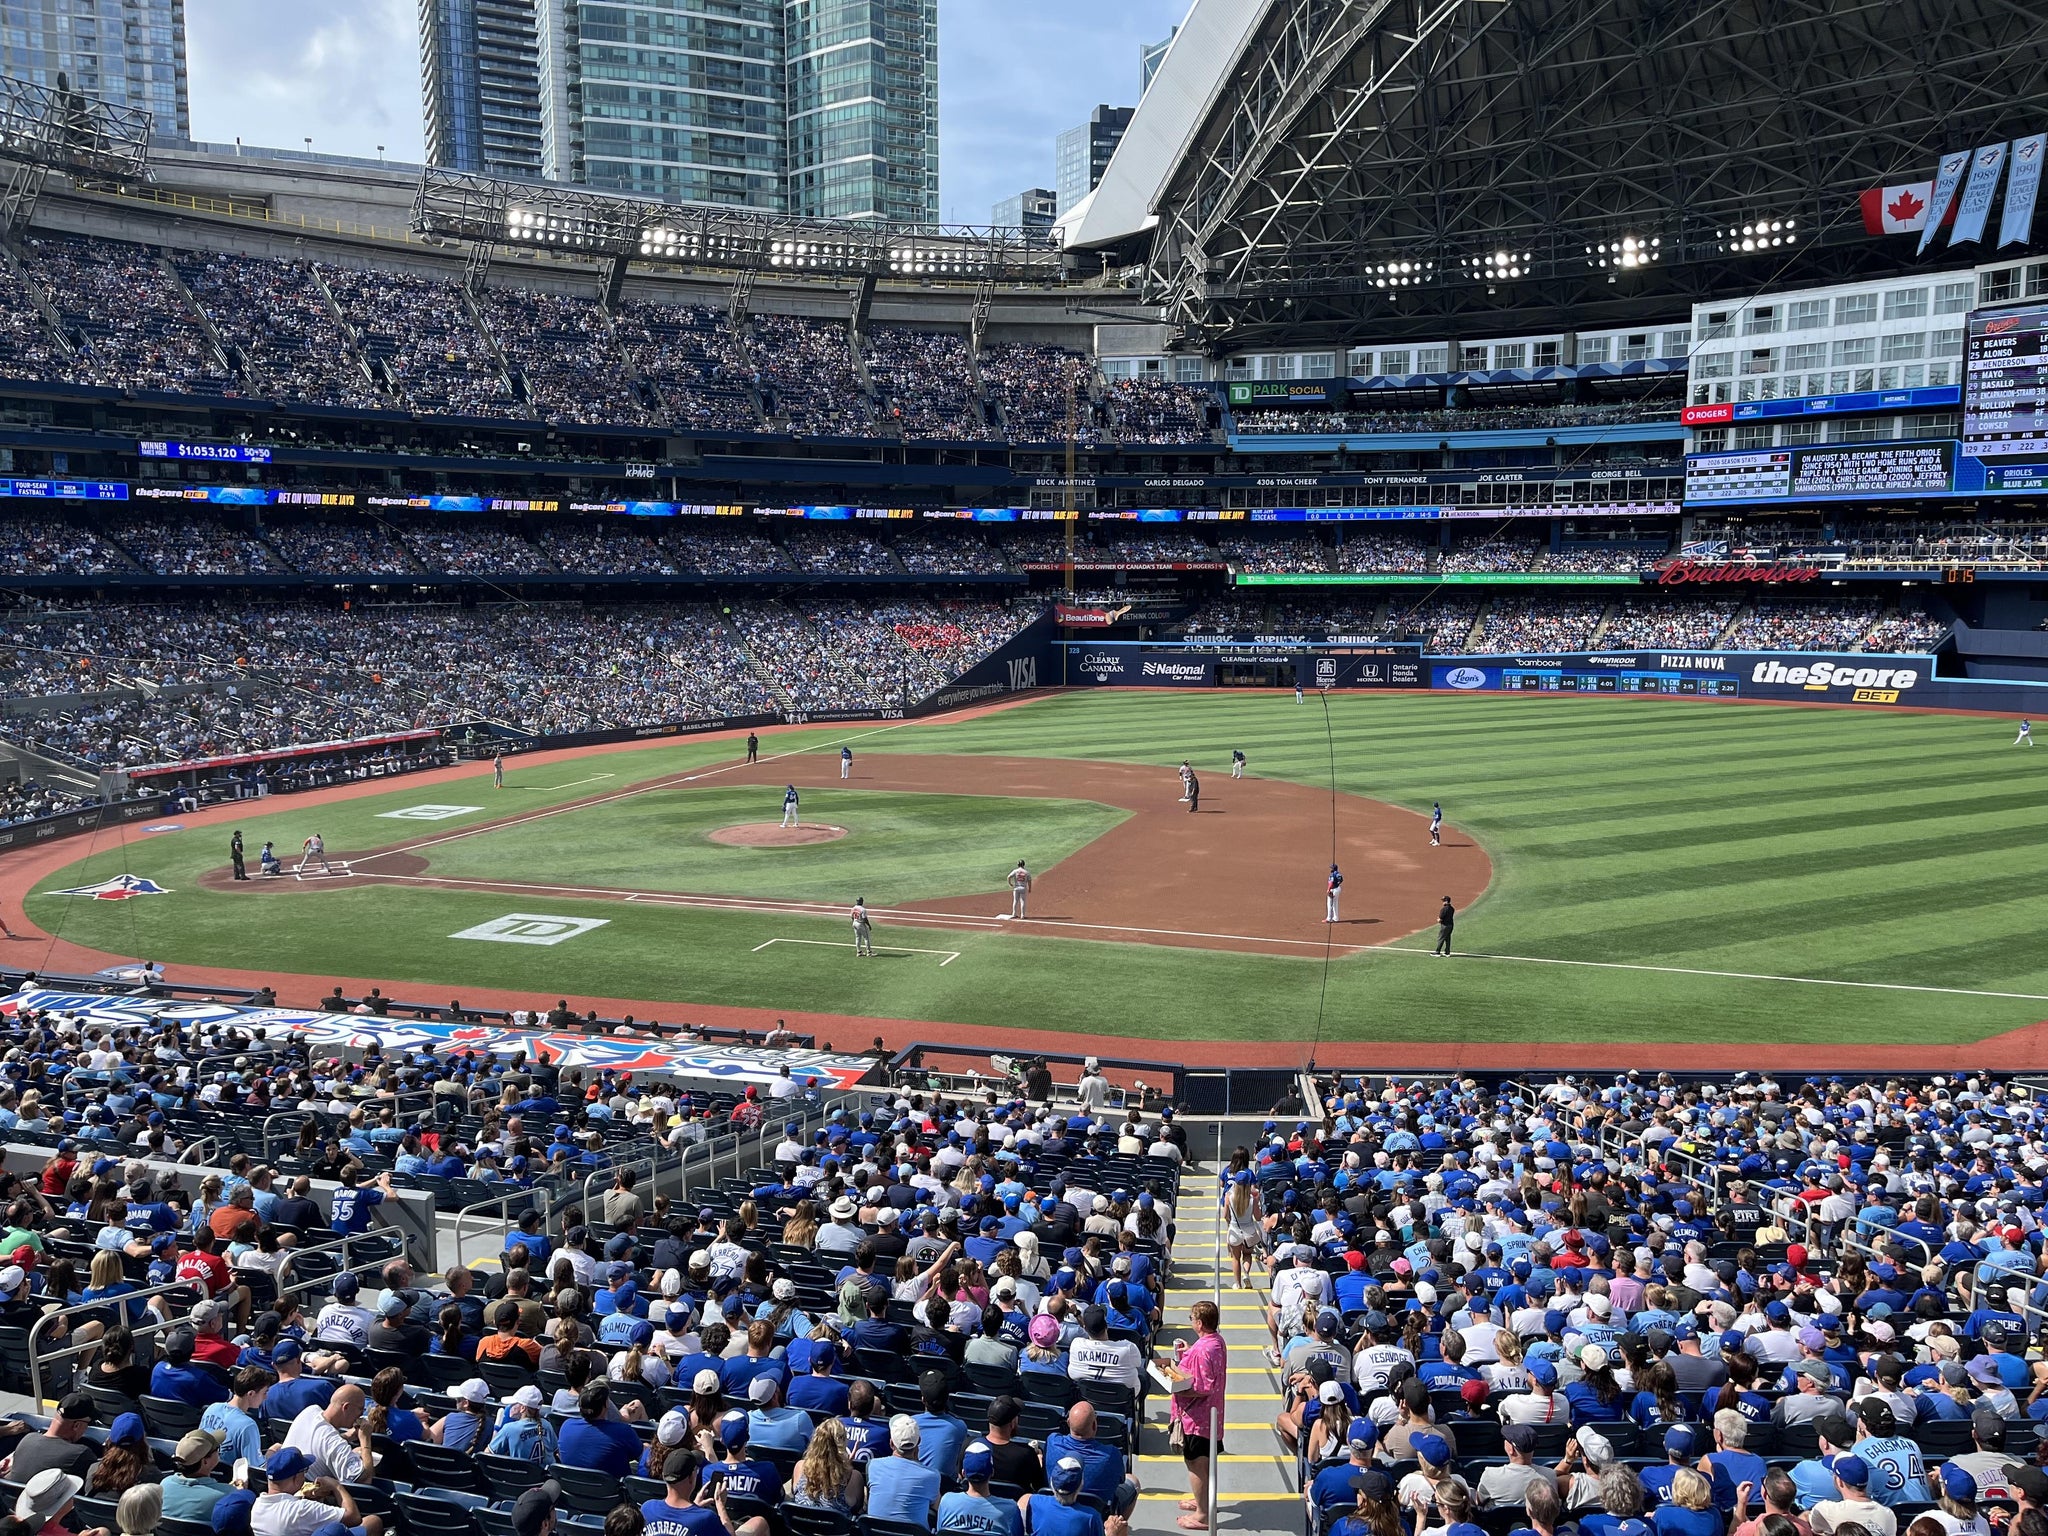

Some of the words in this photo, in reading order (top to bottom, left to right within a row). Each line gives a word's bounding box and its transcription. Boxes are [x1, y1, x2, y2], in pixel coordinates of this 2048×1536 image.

[1973, 169, 1997, 181] 1989
[2016, 166, 2036, 178] 1991
[2013, 177, 2037, 186] AMERICAN
[1967, 188, 1992, 198] LEAGUE
[2011, 185, 2035, 194] LEAGUE
[1964, 197, 1990, 207] EAST
[2009, 194, 2033, 205] EAST
[1983, 338, 2017, 348] BEAVERS
[1983, 349, 2013, 358] ALONSO
[1983, 358, 2026, 368] HENDERSON
[1981, 370, 2003, 379] MAYO
[1981, 379, 2014, 389] BASALLO
[1231, 386, 1250, 400] TD
[1253, 383, 1288, 395] PARK
[1289, 386, 1326, 394] SOCIAL
[1979, 400, 2016, 410] HOLLIDAY
[1695, 409, 1727, 419] ROGERS
[1979, 411, 2012, 420] TAVERAS
[1978, 422, 2008, 431] COWSER
[141, 441, 167, 450] WINNER
[1965, 445, 1977, 453] 129
[1802, 455, 1811, 463] ON
[1813, 454, 1838, 462] AUGUST
[1839, 453, 1850, 461] 30,
[1851, 451, 1879, 460] BECAME
[1895, 450, 1915, 458] FIFTH
[1916, 448, 1942, 457] ORIOLE
[1707, 458, 1721, 466] 2026
[1721, 457, 1741, 465] SEASON
[1741, 456, 1757, 464] STATS
[1801, 462, 1823, 470] (SINCE
[1824, 461, 1842, 469] 1954)
[1843, 460, 1860, 468] WITH
[1861, 459, 1876, 467] TWO
[1877, 458, 1897, 466] HOME
[1898, 457, 1918, 465] RUNS
[1591, 471, 1622, 479] GEORGE
[1799, 469, 1821, 477] TRIPLE
[1837, 467, 1860, 476] SINGLE
[1884, 465, 1913, 474] JOINING
[1914, 464, 1942, 472] NELSON
[1036, 478, 1055, 486] BUCK
[1256, 478, 1274, 486] 4306
[1294, 478, 1318, 486] CHEEK
[1386, 476, 1427, 484] FERNANDEZ
[1478, 474, 1493, 482] JOE
[1495, 473, 1523, 481] CARTER
[1794, 477, 1811, 485] CRUZ
[1835, 475, 1856, 483] CHRIS
[1857, 473, 1887, 482] RICHARD
[1916, 471, 1948, 480] JEFFREY
[1794, 483, 1830, 492] HAMMONDS
[1855, 482, 1870, 490] AND
[1885, 480, 1911, 489] RIPKEN
[1925, 479, 1946, 488] (1991)
[136, 488, 183, 498] theScore
[278, 492, 292, 504] BET
[292, 493, 302, 504] ON
[303, 493, 322, 505] YOUR
[322, 493, 339, 505] BLUE
[338, 495, 355, 506] JAYS
[1654, 559, 1820, 584] Budweiser
[1122, 613, 1146, 621] RETHINK
[1148, 612, 1170, 620] COLOUR
[1084, 653, 1120, 665] CLEARLY
[1661, 654, 1692, 668] PIZZA
[1695, 656, 1725, 670] NOVA
[1079, 663, 1124, 673] CANADIAN
[1156, 662, 1206, 675] National
[1007, 656, 1037, 691] VISA
[1454, 669, 1479, 685] Leon's
[1752, 661, 1917, 689] theScore
[1857, 691, 1896, 700] BET
[880, 709, 904, 719] VISA
[682, 722, 712, 731] BASELINE
[713, 721, 725, 729] BOX
[131, 805, 154, 815] clover
[36, 827, 56, 837] KPMG
[332, 1200, 356, 1221] 55
[1734, 1213, 1760, 1221] FIRE
[1673, 1228, 1699, 1239] CLEMENT
[1487, 1277, 1505, 1287] KIRK
[350, 1329, 363, 1341] JR
[600, 1322, 632, 1338] OKAMOT
[918, 1342, 946, 1356] CLEMENT
[1077, 1350, 1119, 1365] OKAMOTO
[1088, 1365, 1106, 1380] 7
[1864, 1439, 1915, 1460] GAUSMAN
[1877, 1453, 1927, 1490] 34
[954, 1514, 994, 1532] JANSEN
[1959, 1521, 1977, 1533] KIRK
